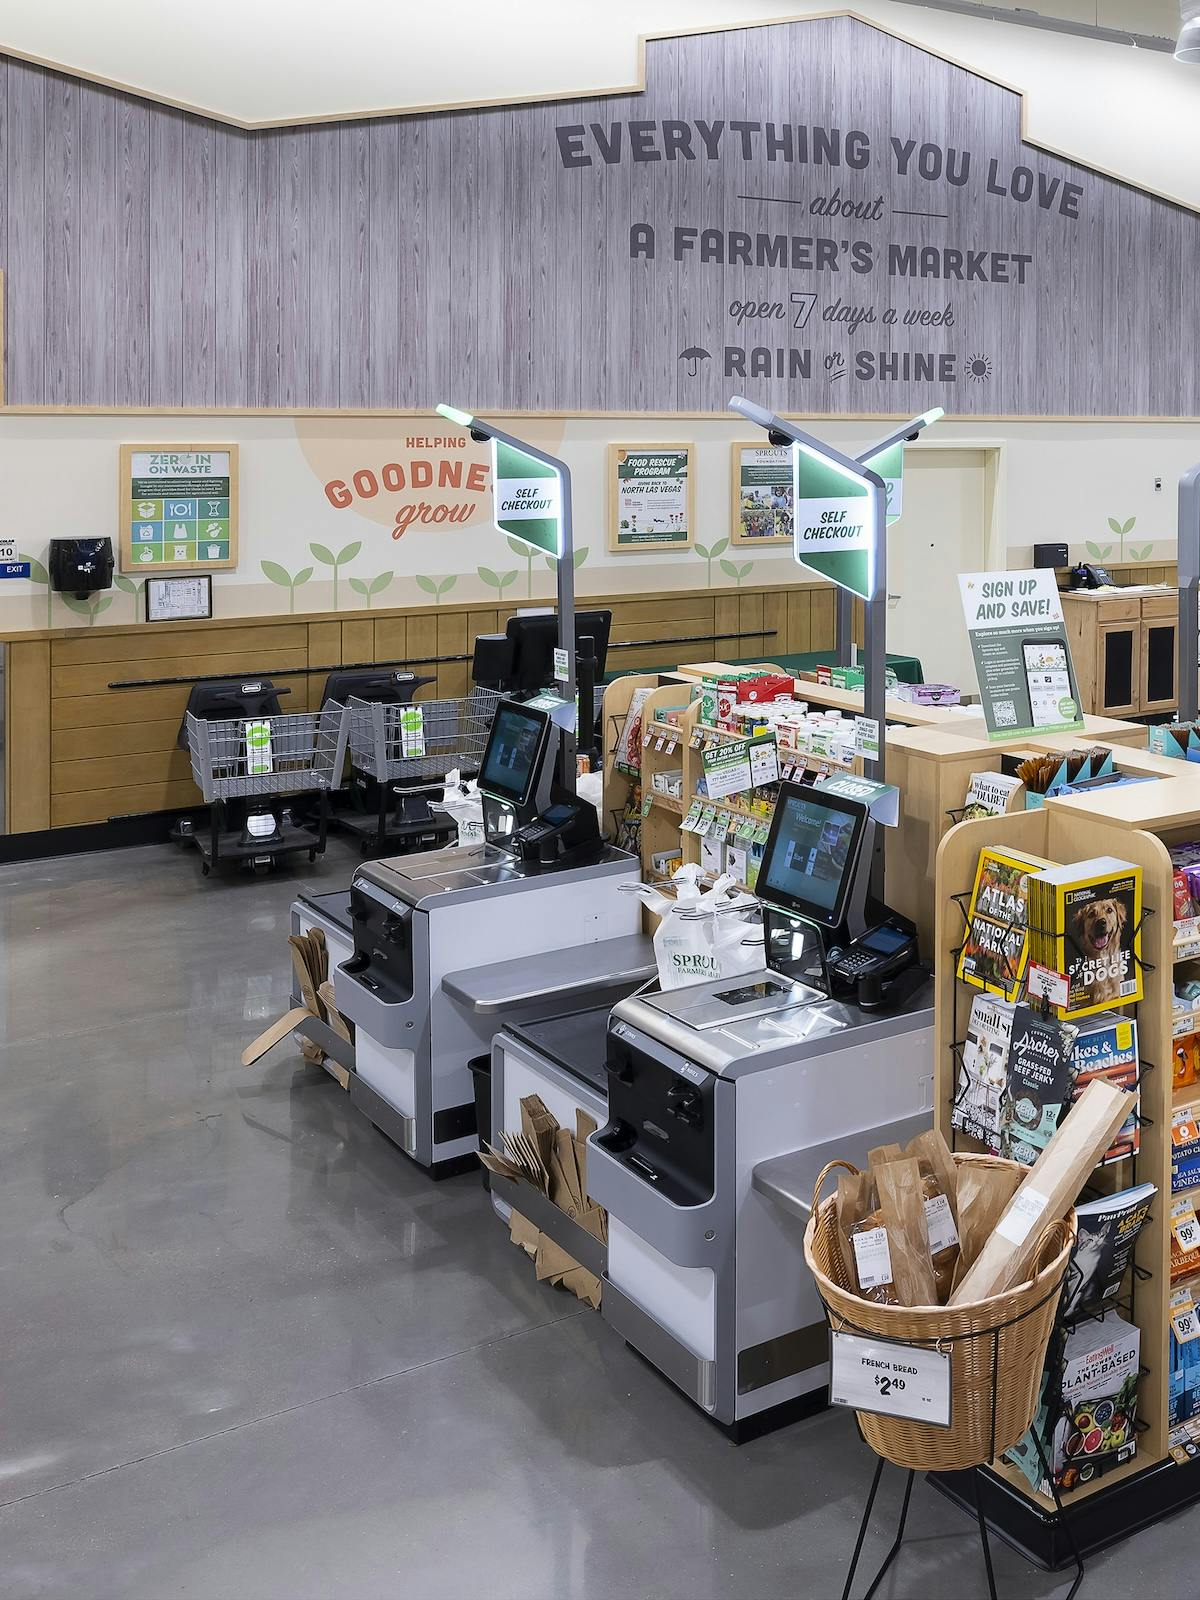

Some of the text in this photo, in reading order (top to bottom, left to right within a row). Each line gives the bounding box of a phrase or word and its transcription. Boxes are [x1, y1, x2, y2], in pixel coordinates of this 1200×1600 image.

[555, 120, 1084, 220] EVERYTHING YOU LOVE
[809, 188, 884, 222] about
[630, 223, 1032, 284] A FARMER'S MARKET
[729, 292, 955, 335] open 7 days a week
[723, 346, 957, 382] RAIN SHINE
[406, 437, 466, 448] HELPING
[196, 455, 211, 464] IN
[649, 458, 676, 466] RESCUE
[634, 467, 671, 475] PROGRAM
[516, 488, 538, 499] SELF
[501, 499, 551, 511] CHECKOUT
[392, 501, 476, 540] grow
[820, 511, 847, 523] SELF
[803, 525, 863, 540] CHECKOUT
[982, 580, 1037, 598] SIGN UP
[976, 599, 1051, 620] AND SAVE!
[705, 743, 746, 759] GET 20% OFF
[974, 781, 990, 792] what
[981, 886, 1025, 913] ATLAS
[988, 907, 1011, 921] OF THE
[1111, 950, 1131, 964] LIFE
[1084, 960, 1128, 986] DOGS
[974, 1009, 1001, 1031] small
[1030, 1030, 1052, 1040] COUNTRY
[1013, 1032, 1059, 1066] Archer
[1101, 1041, 1112, 1054] &
[1017, 1057, 1052, 1076] GRASS-FED
[1074, 1051, 1133, 1074] Beaches
[1014, 1064, 1055, 1085] BEEF JERKY
[1022, 1078, 1039, 1090] Classic
[1180, 1227, 1194, 1240] 99¢
[1178, 1317, 1192, 1331] 99¢
[1086, 1344, 1115, 1364] EatingWell
[1092, 1357, 1111, 1367] POWER
[861, 1357, 918, 1376] FRENCH BREAD
[1061, 1350, 1135, 1389] PLANT-BASED
